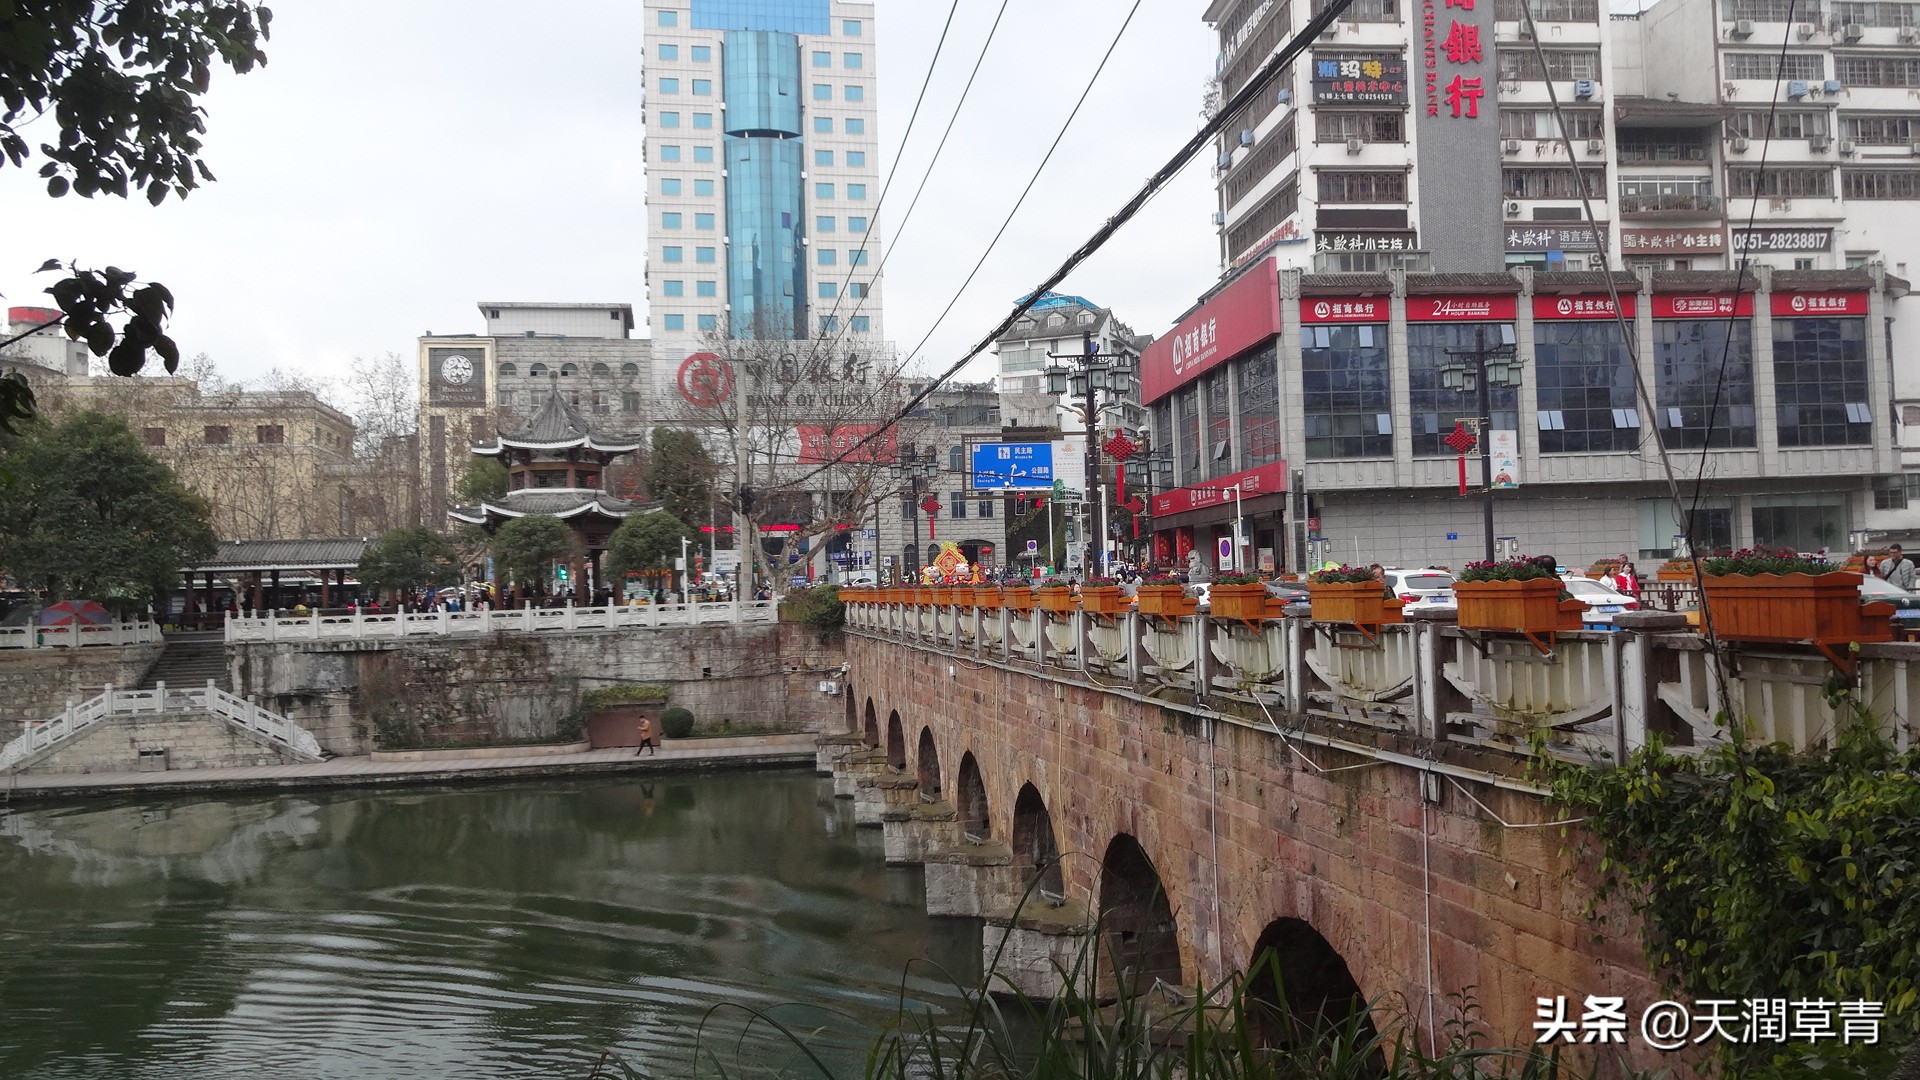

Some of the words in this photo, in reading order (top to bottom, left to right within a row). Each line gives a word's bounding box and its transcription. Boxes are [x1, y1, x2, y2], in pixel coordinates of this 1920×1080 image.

[1423, 0, 1435, 68] CHANTS
[1440, 0, 1485, 118] 銀行
[1733, 232, 1828, 250] 0851-28238817
[1332, 303, 1374, 313] 招商银行
[1432, 300, 1451, 316] 24
[1574, 300, 1615, 310] 招商银行
[1808, 297, 1847, 307] 招商银行
[1185, 317, 1217, 359] 招商银行
[796, 395, 815, 406] OF
